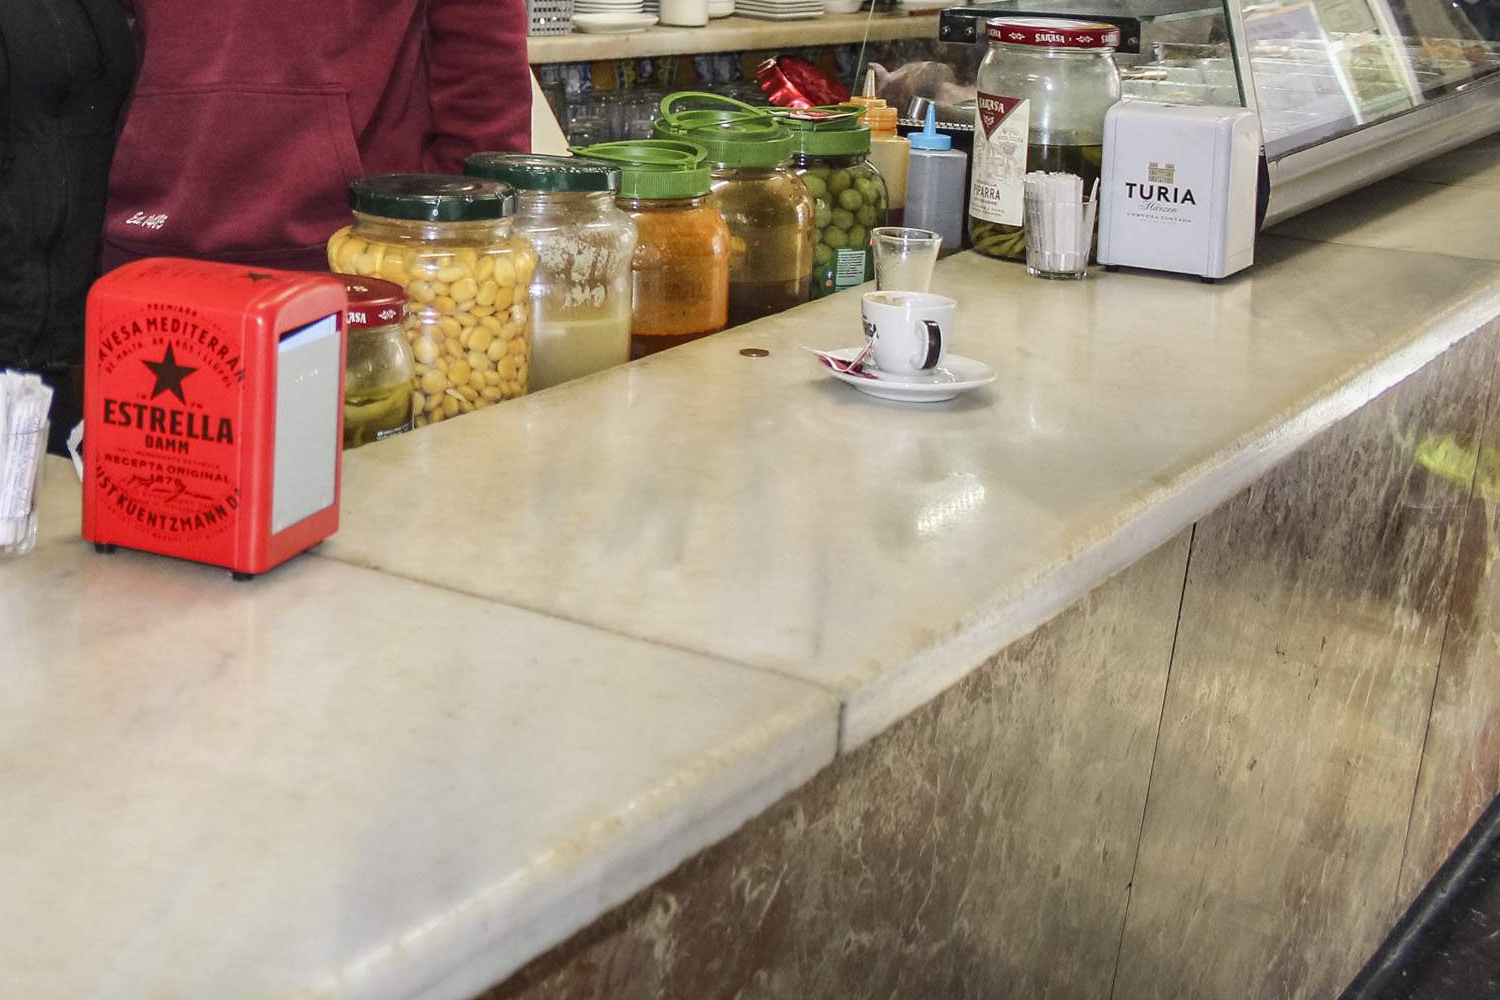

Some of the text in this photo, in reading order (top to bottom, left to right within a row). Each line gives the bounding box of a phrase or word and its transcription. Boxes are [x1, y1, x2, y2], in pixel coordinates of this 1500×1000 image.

[1125, 181, 1197, 206] TURIA
[98, 321, 143, 362] RVESA
[103, 397, 235, 445] ESTRELLA
[145, 434, 190, 455] DAMM
[104, 453, 164, 472] RECEPTA
[166, 465, 230, 484] ORIGINAL
[116, 493, 229, 533] KUENTZMANN
